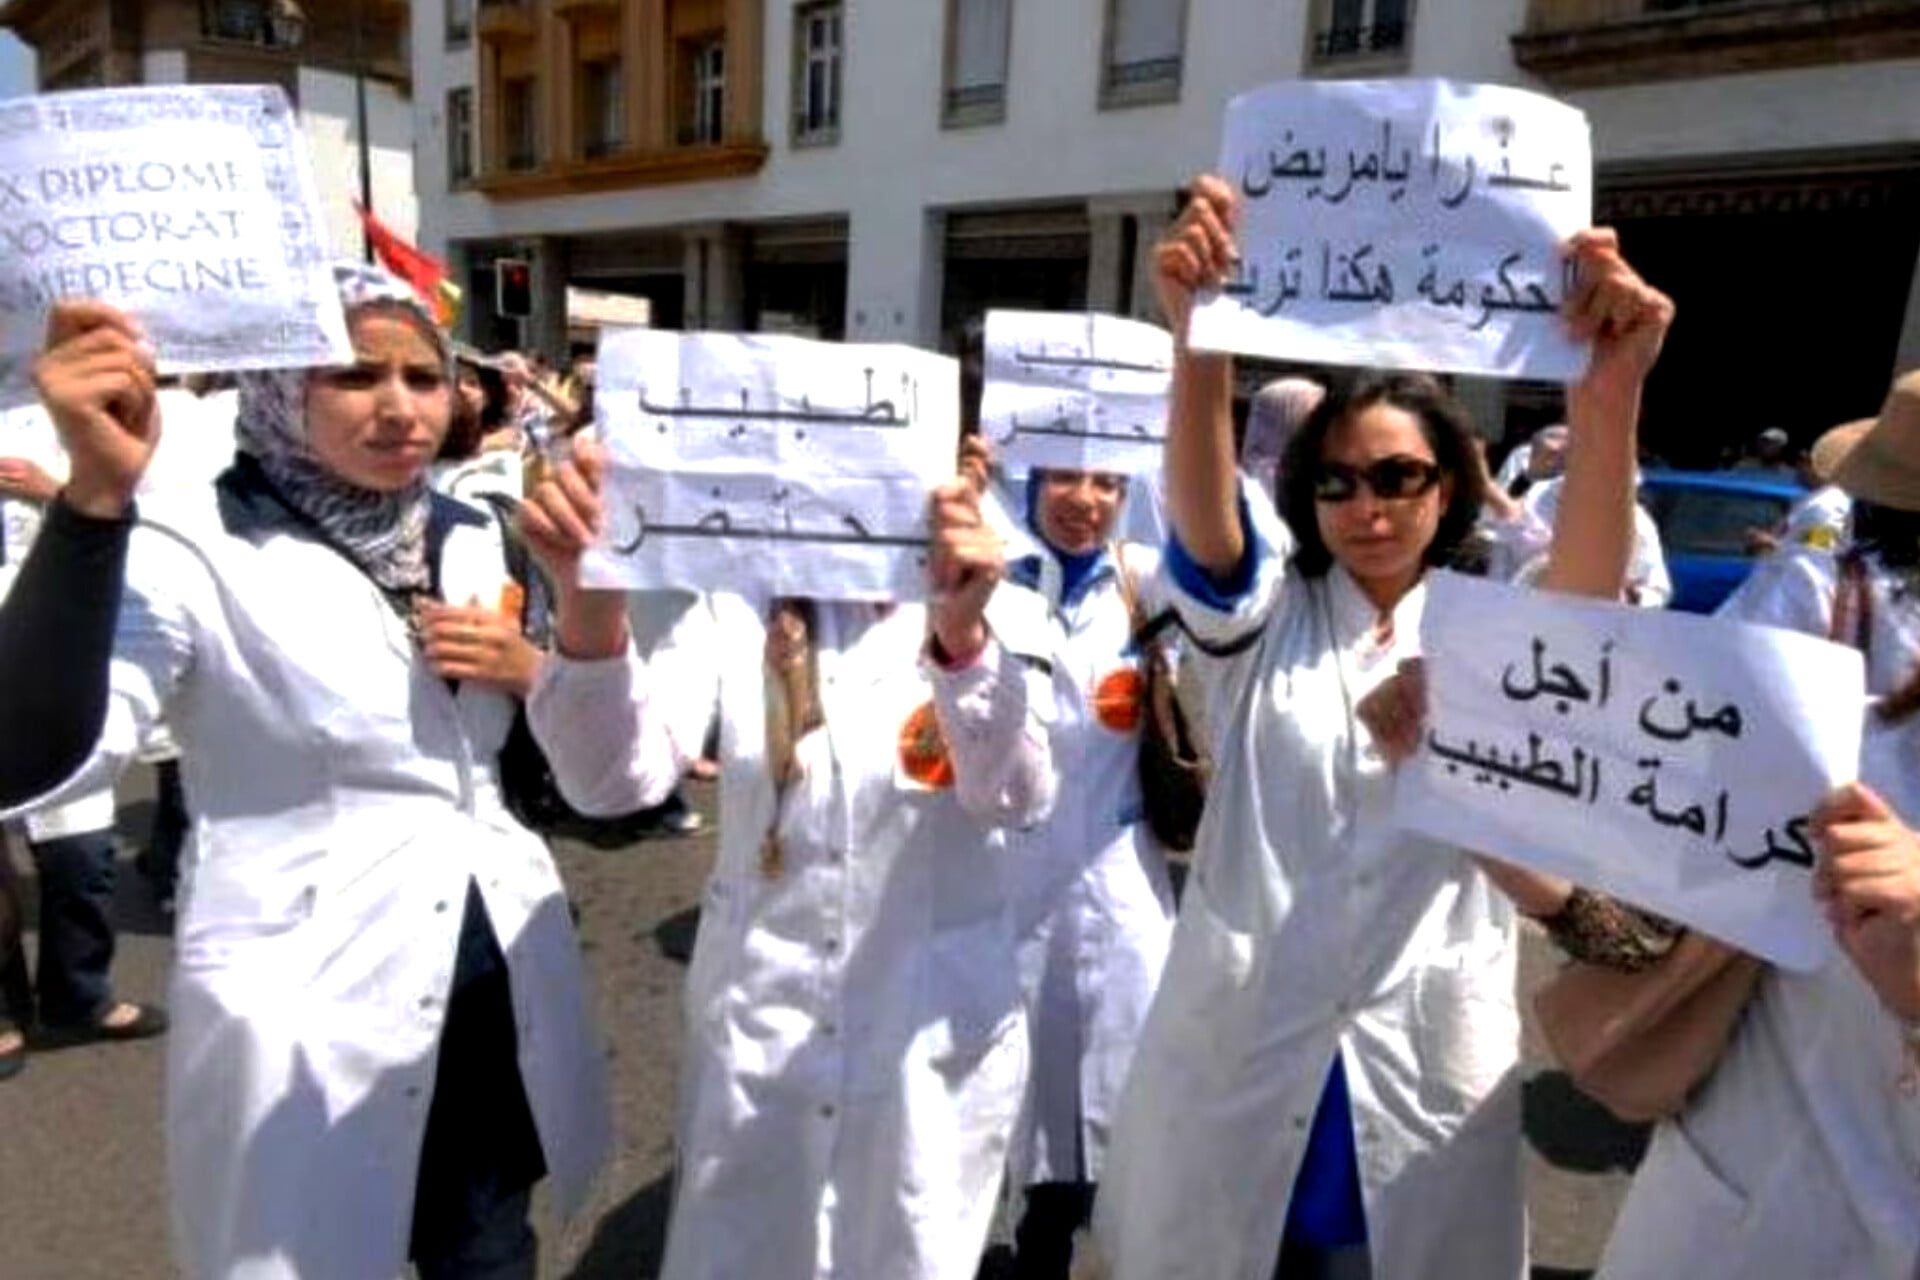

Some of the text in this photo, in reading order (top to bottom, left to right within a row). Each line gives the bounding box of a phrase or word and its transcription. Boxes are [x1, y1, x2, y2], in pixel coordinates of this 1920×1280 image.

[1241, 117, 1411, 203] يامريض
[1502, 636, 1744, 741] من أجل
[1427, 729, 1817, 871] كرامة الطبيب
